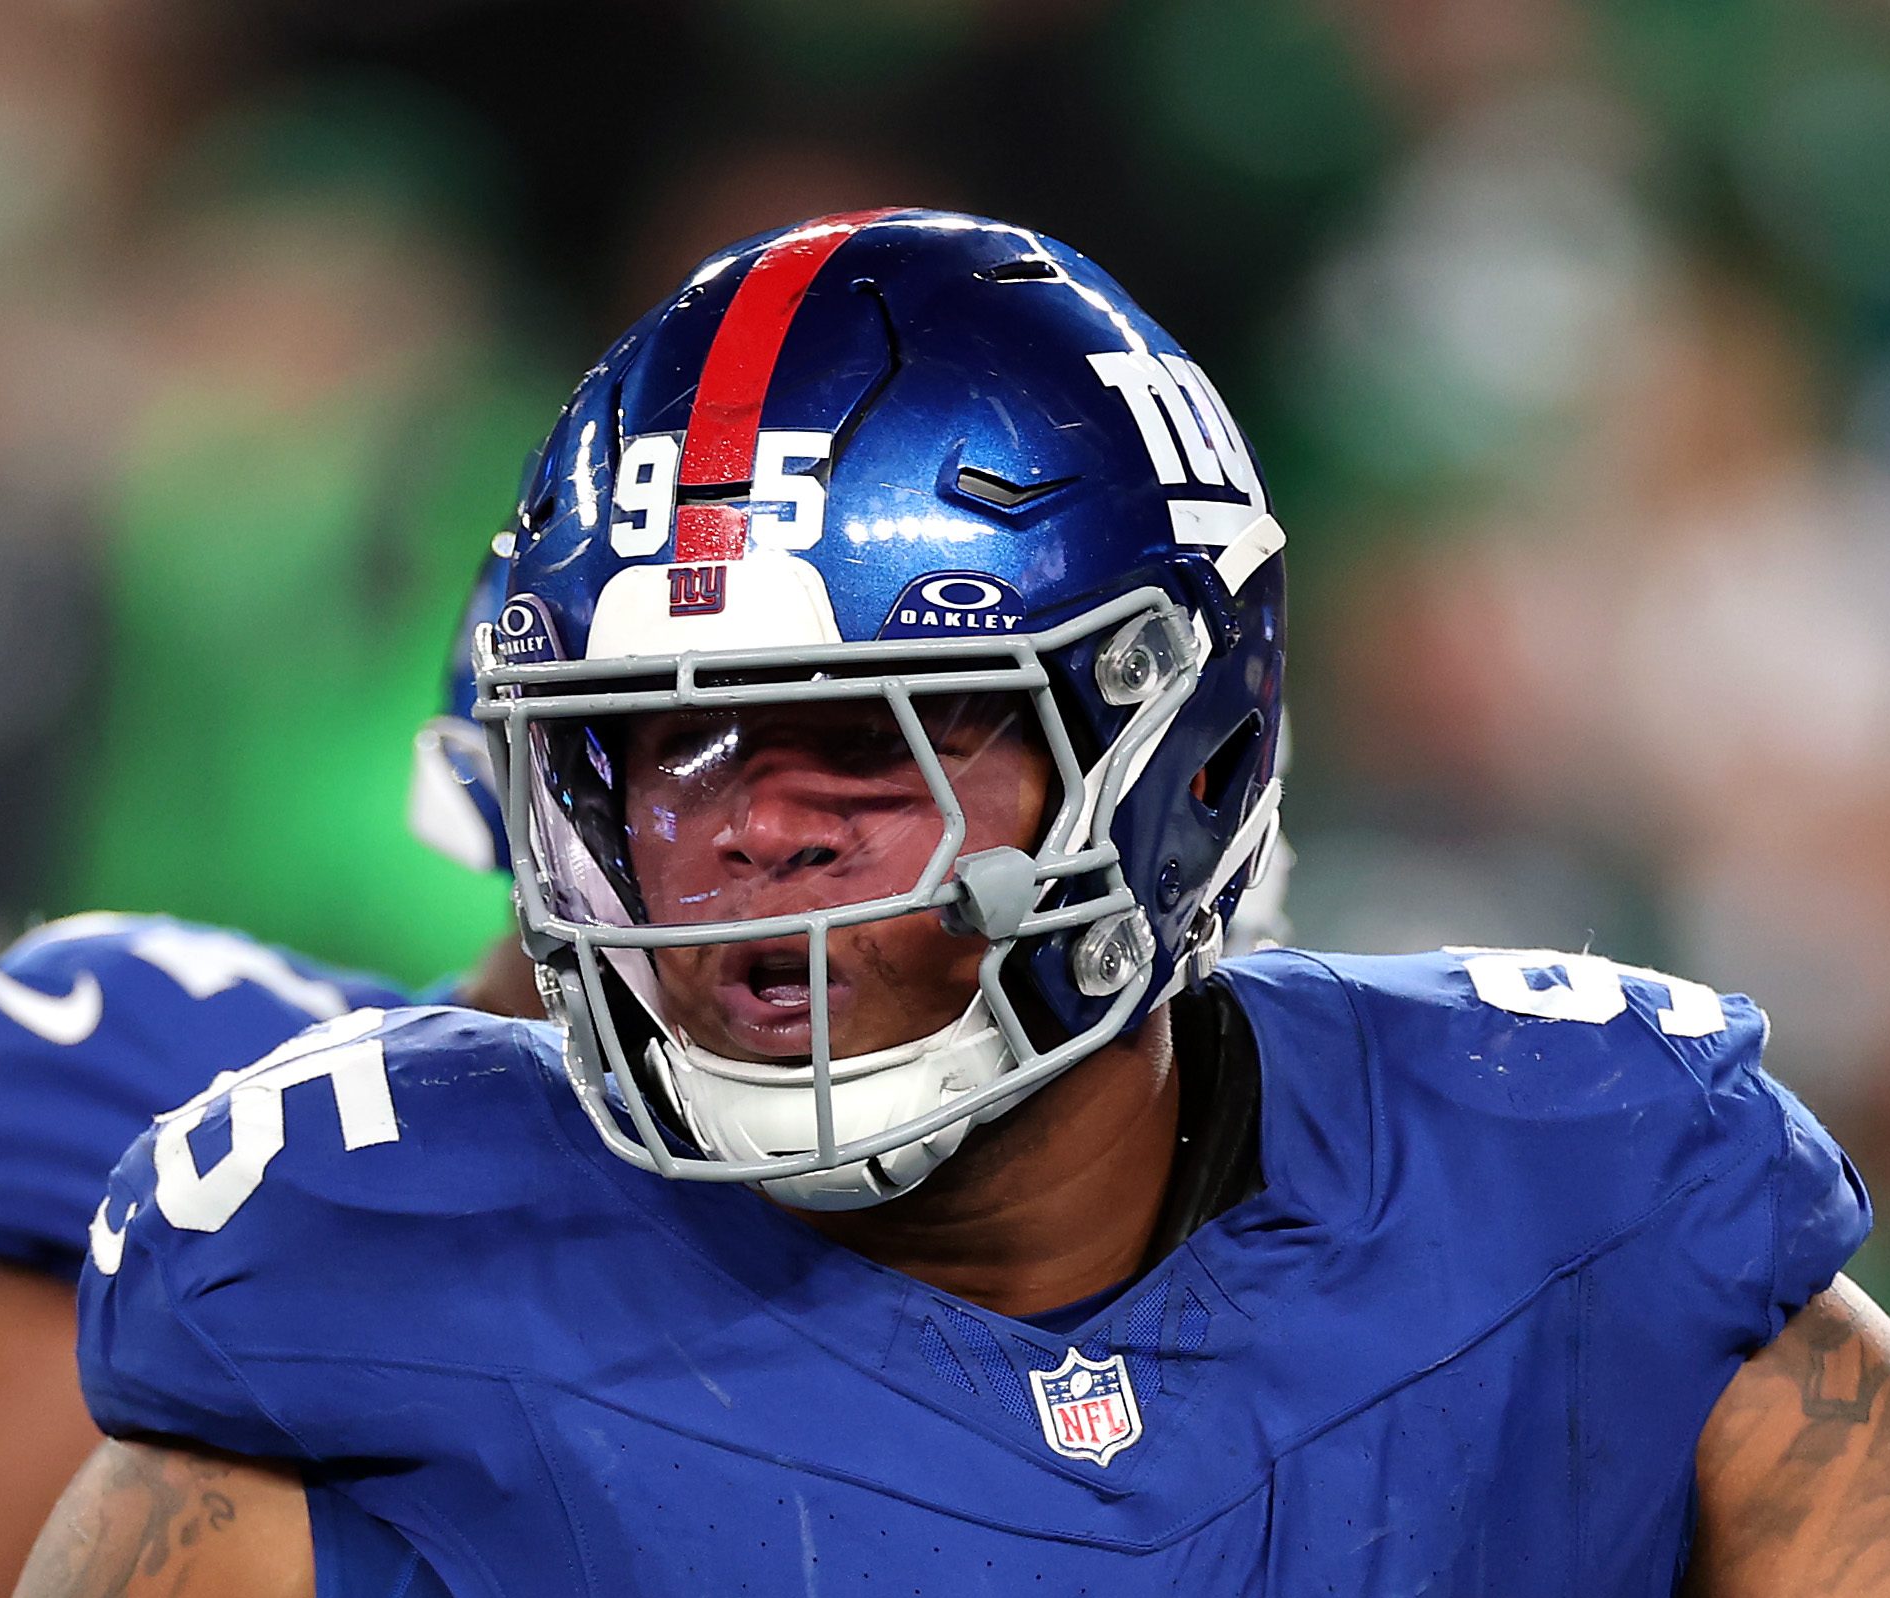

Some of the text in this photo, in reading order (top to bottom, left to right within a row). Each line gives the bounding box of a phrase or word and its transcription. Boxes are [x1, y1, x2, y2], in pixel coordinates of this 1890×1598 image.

[667, 566, 727, 617] ny
[900, 609, 1023, 629] OAKLEY
[1057, 1398, 1126, 1445] NFL
